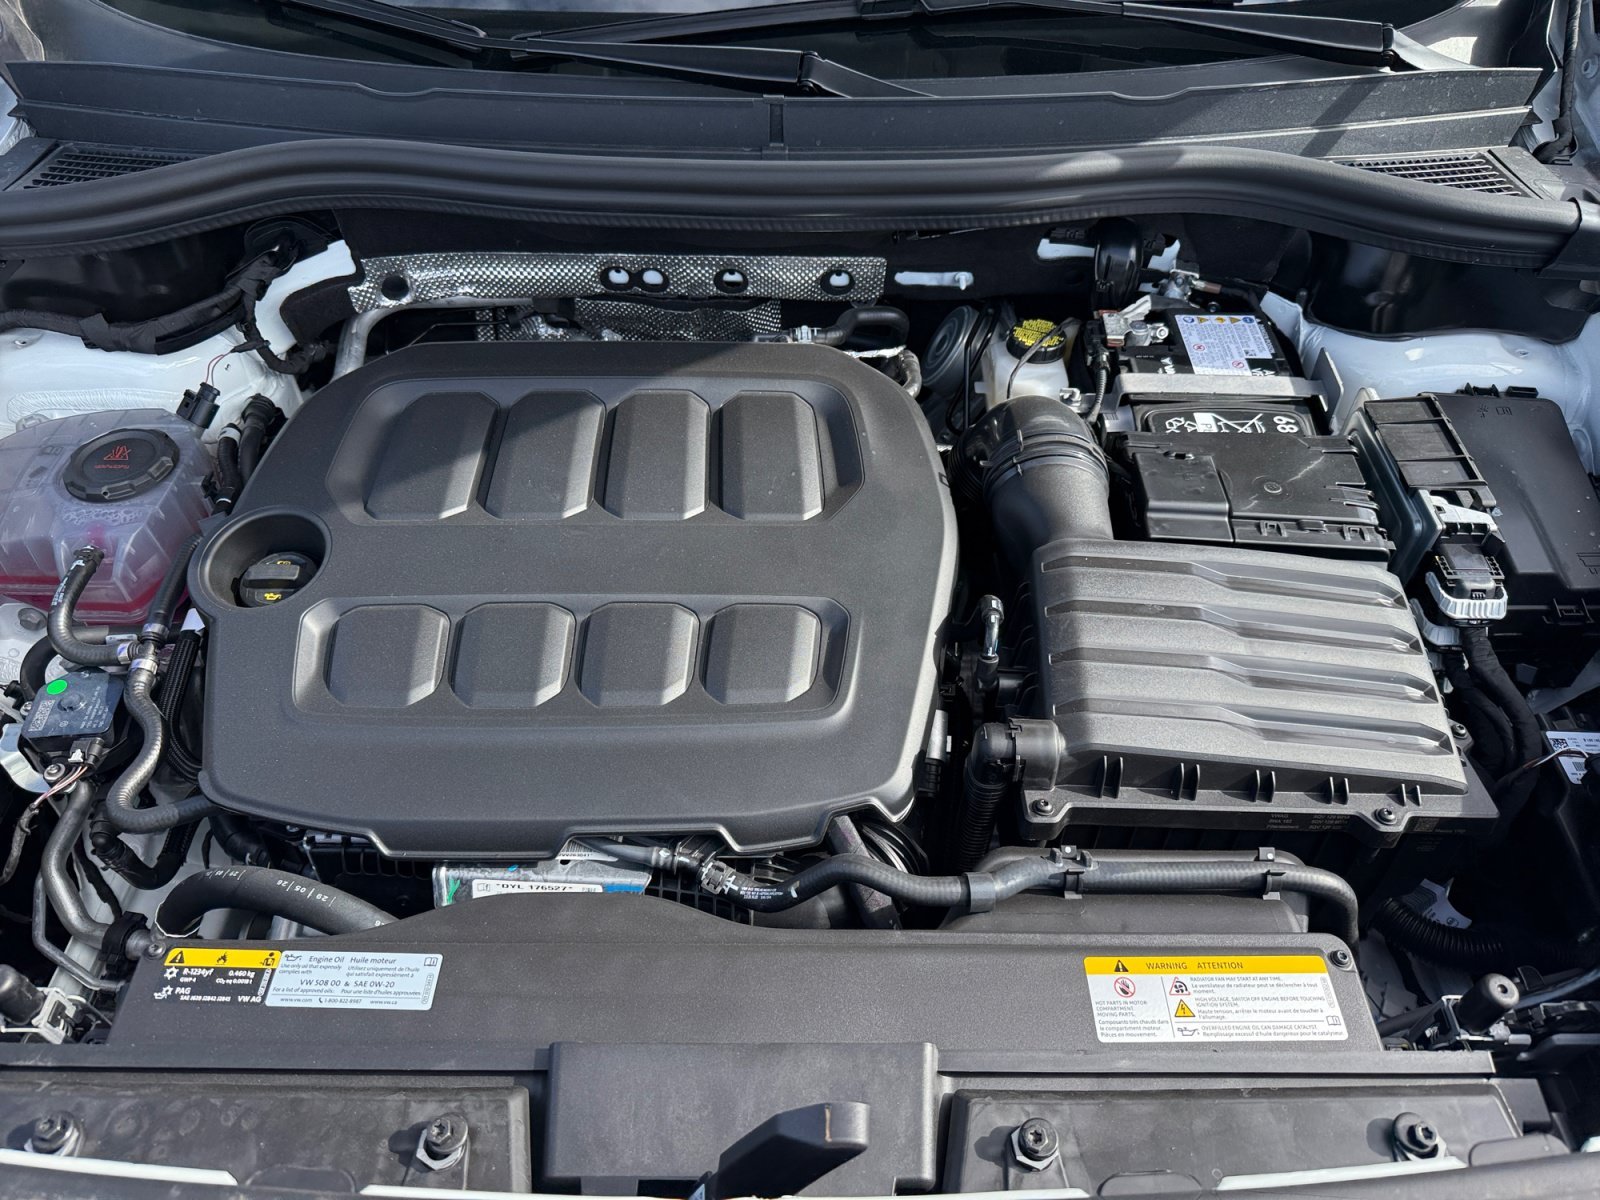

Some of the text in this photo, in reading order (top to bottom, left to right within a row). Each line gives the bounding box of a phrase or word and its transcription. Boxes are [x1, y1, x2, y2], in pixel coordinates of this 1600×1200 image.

[1273, 416, 1299, 434] 68
[308, 956, 333, 964] Engine
[1197, 962, 1244, 970] ATTENTION
[182, 968, 214, 977] R-1234yf
